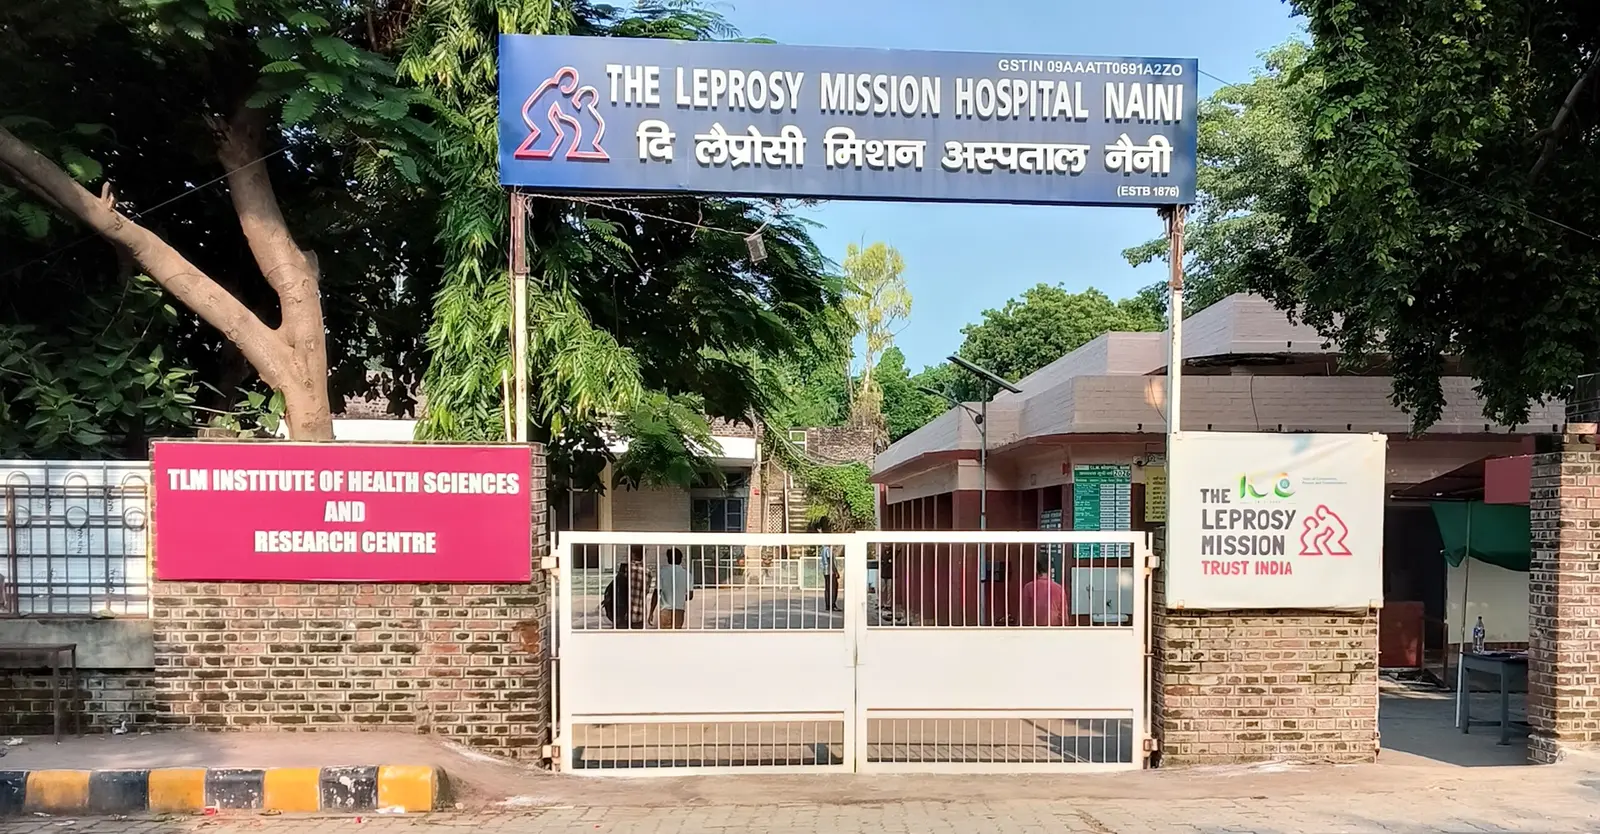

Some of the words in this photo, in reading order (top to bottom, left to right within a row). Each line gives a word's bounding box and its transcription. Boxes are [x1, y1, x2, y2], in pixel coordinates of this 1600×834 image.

[998, 60, 1043, 72] GSTIN
[606, 64, 660, 105] THE
[677, 67, 804, 111] LEPROSY
[821, 73, 940, 115] MISSION
[957, 78, 1089, 119] HOSPITAL
[1106, 83, 1183, 122] NAINI
[636, 120, 675, 161] दि
[695, 123, 806, 166] लैप्रोसी
[824, 127, 926, 169] मिशन
[942, 141, 1090, 173] अस्पताल
[1105, 133, 1173, 174] नैनी
[1117, 185, 1151, 197] (ESTB
[1153, 186, 1179, 197] 1876)
[168, 469, 208, 490] TLM
[213, 470, 315, 491] INSTITUTE
[320, 471, 344, 491] OF
[348, 471, 419, 492] HEALTH
[424, 472, 519, 494] SCIENCES
[1200, 489, 1230, 503] THE
[325, 501, 365, 522] AND
[1202, 509, 1296, 530] LEPROSY
[255, 531, 357, 552] RESEARCH
[362, 532, 436, 553] CENTRE
[1202, 535, 1284, 555] MISSION
[1202, 561, 1248, 575] TRUST
[1256, 561, 1291, 575] INDIA
